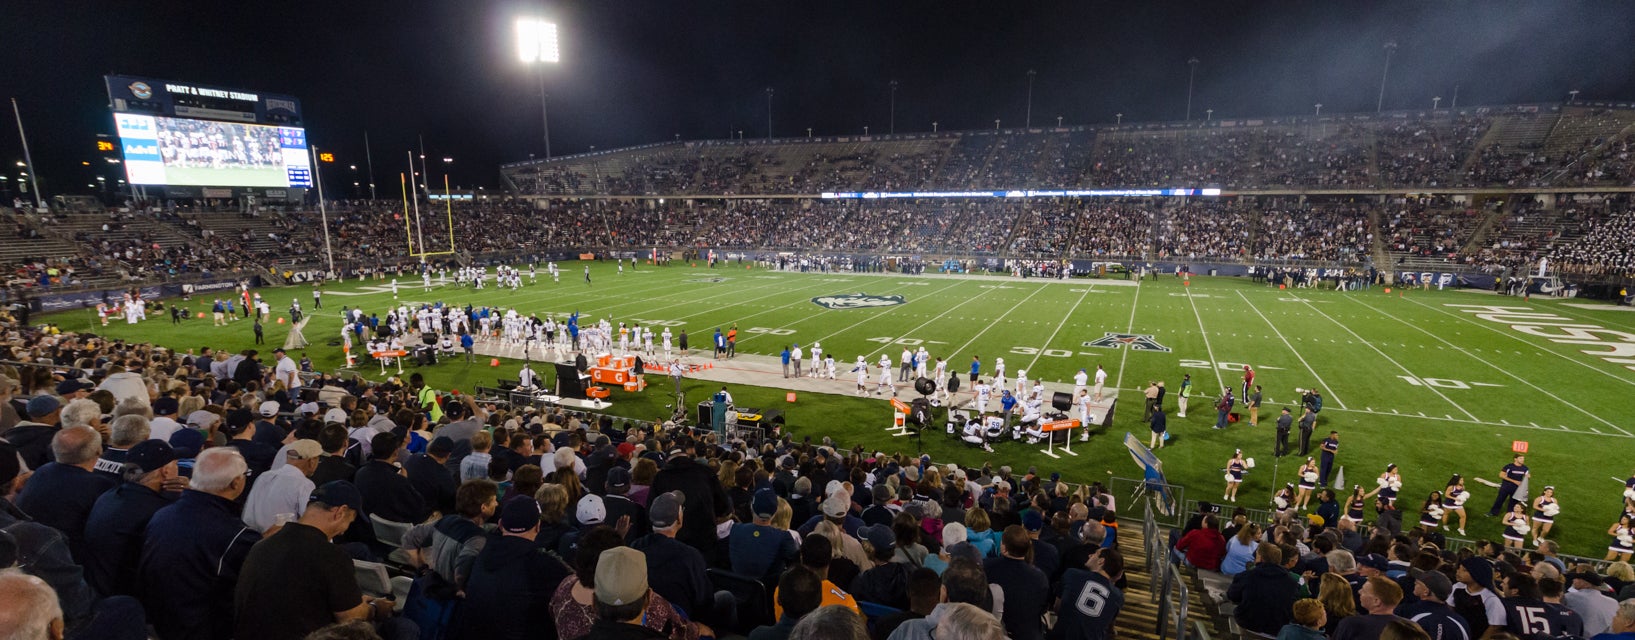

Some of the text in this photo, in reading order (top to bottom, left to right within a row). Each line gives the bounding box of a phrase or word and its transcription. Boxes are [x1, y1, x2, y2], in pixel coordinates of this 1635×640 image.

[165, 83, 258, 101] PRATT & WHITNEY STADIUM
[745, 326, 797, 336] 50
[866, 336, 924, 346] 40
[1009, 346, 1073, 358] 30
[1179, 359, 1252, 371] 20
[615, 373, 623, 383] G
[1396, 375, 1471, 389] 10
[1515, 442, 1526, 451] 10
[1075, 580, 1110, 617] 6
[1516, 605, 1550, 635] 15
